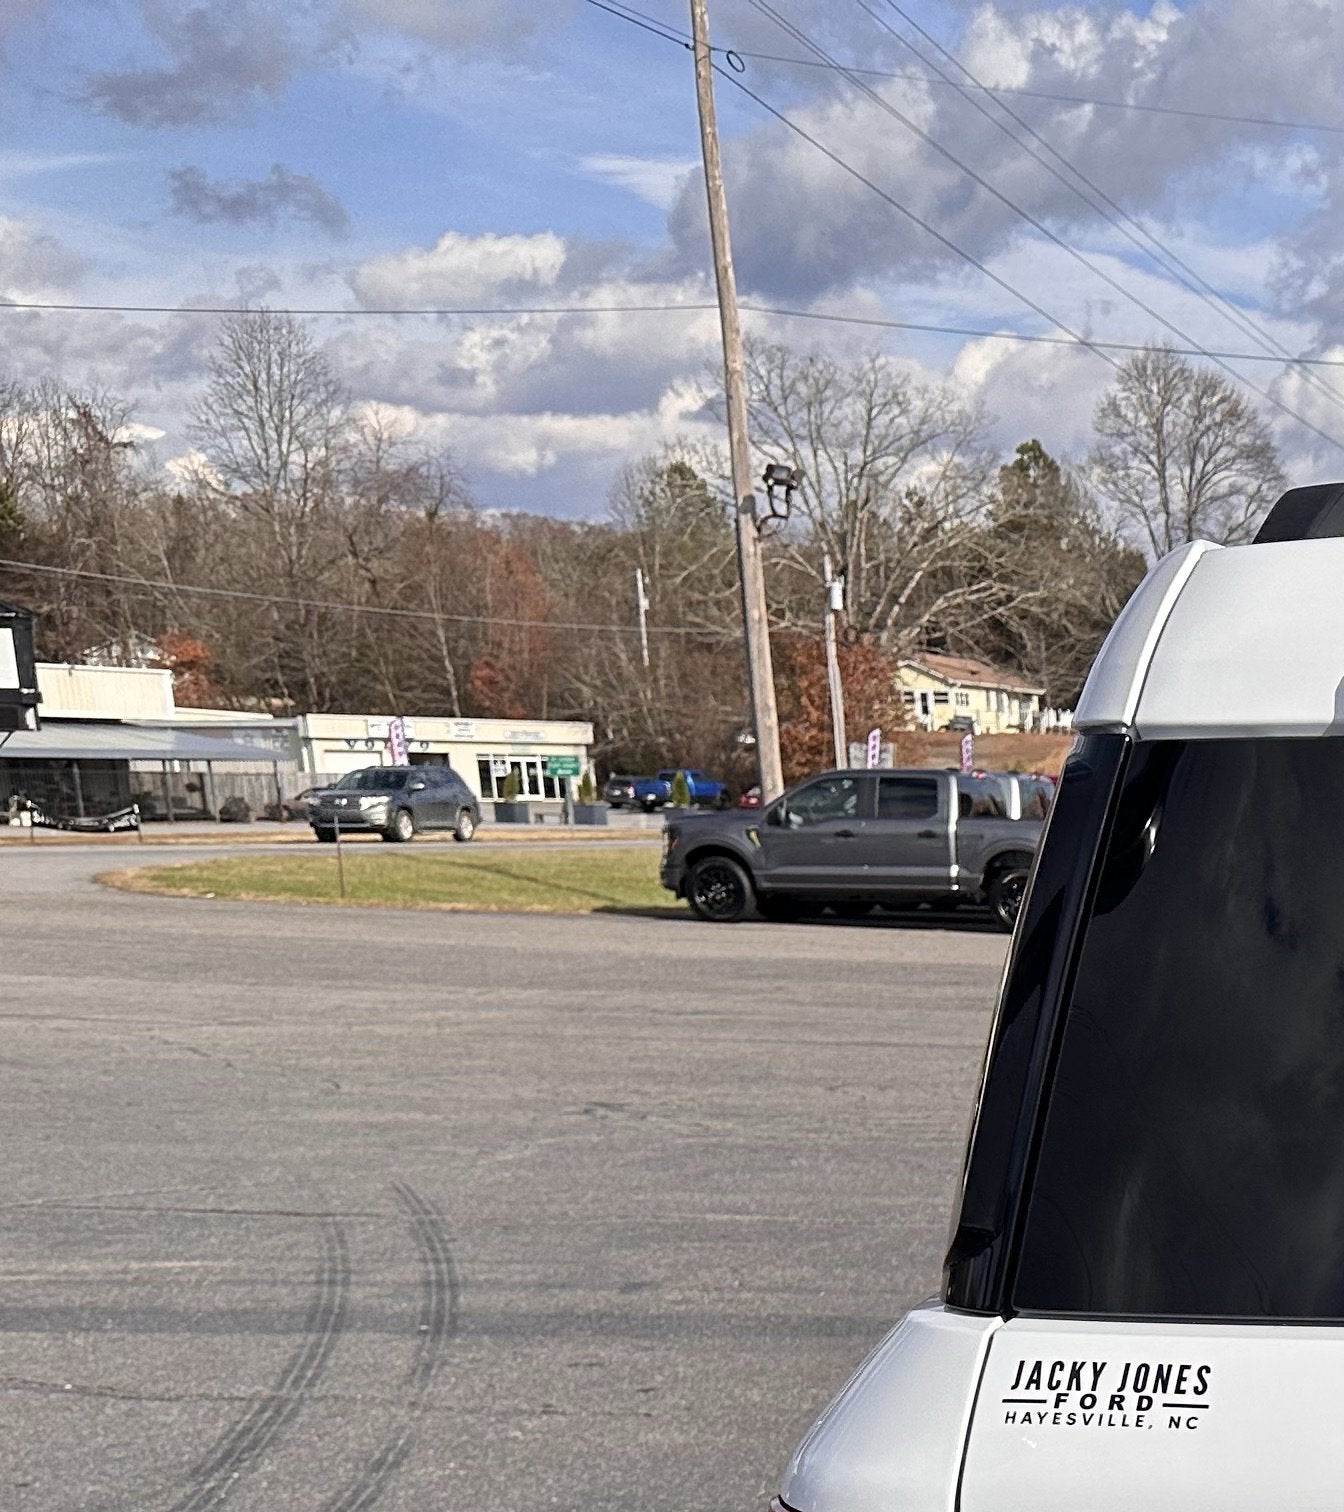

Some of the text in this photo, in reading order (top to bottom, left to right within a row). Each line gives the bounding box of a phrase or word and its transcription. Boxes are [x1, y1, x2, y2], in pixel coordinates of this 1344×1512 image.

[1010, 1359, 1212, 1395] JACKY JONES
[1053, 1392, 1154, 1411] FORD
[1004, 1411, 1199, 1430] HAYESVILLE, NC
